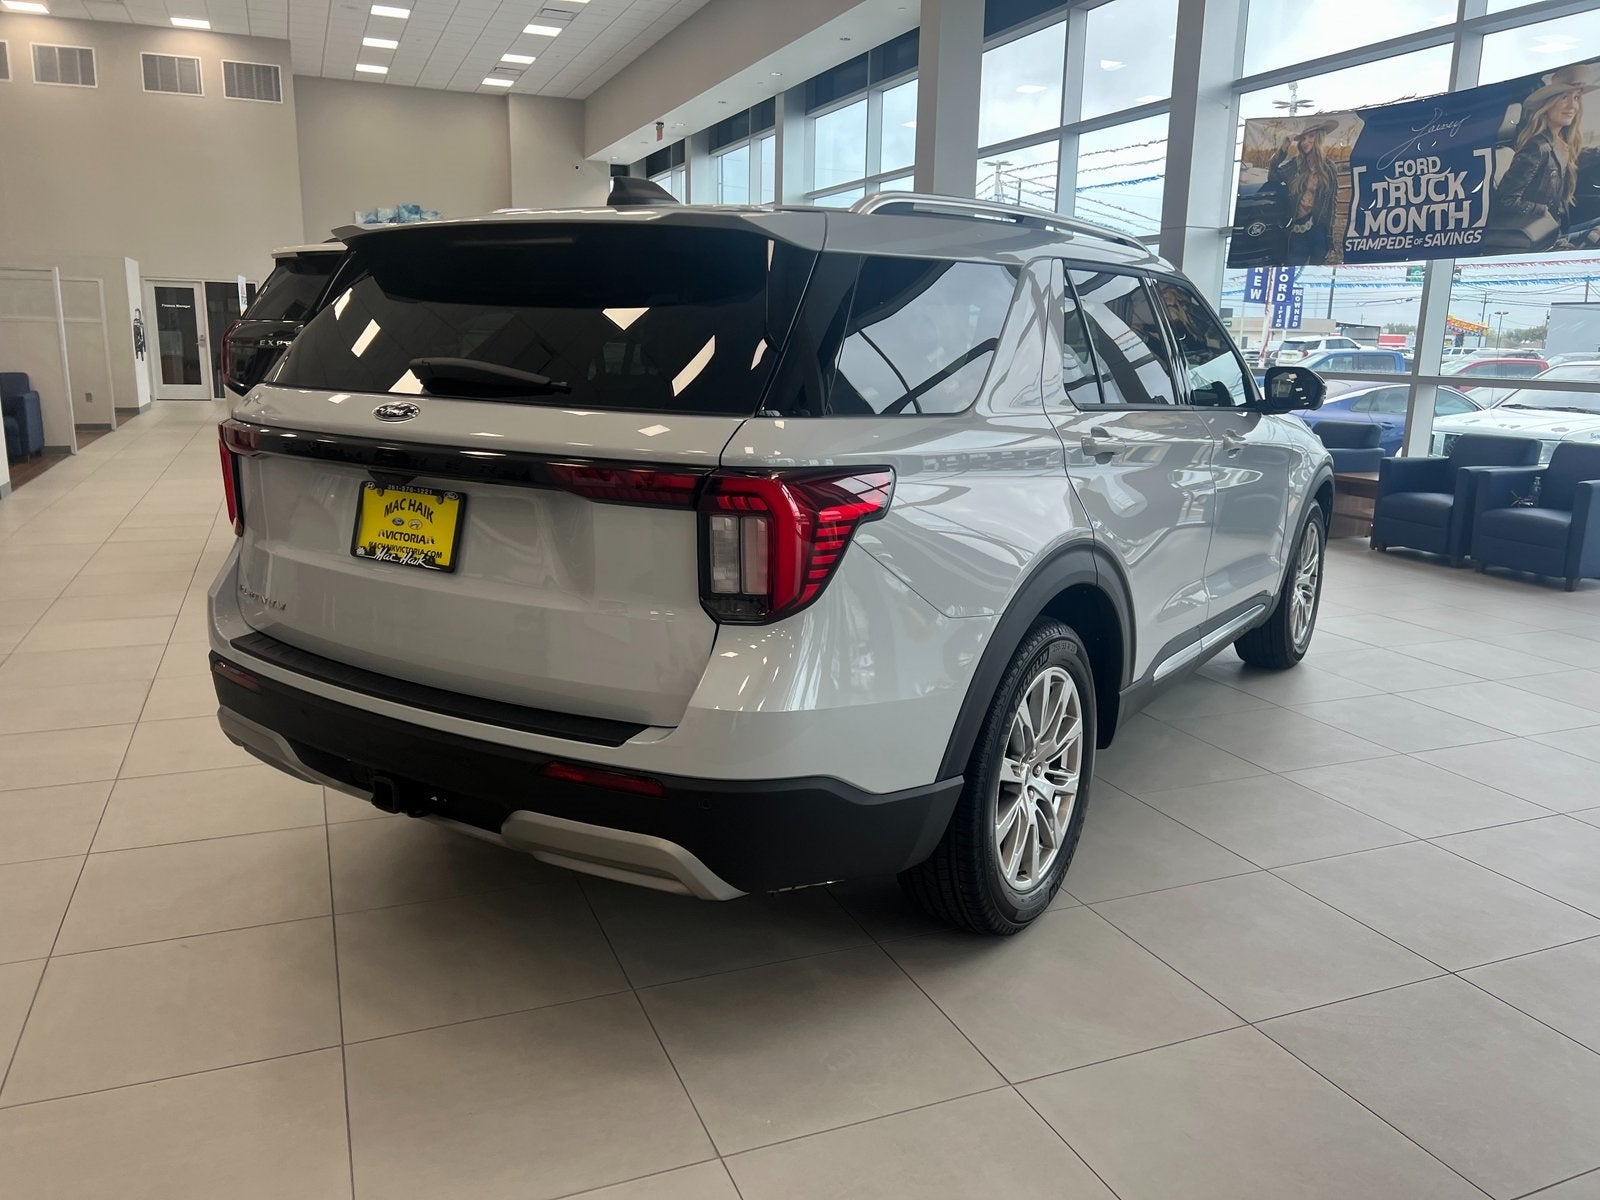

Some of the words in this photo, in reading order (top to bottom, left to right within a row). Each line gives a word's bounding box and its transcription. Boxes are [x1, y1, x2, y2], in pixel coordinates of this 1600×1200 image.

[1395, 156, 1441, 178] FORD
[1372, 168, 1468, 209] TRUCK
[1363, 200, 1472, 237] MONTH
[1345, 235, 1414, 252] STAMPEDE
[1423, 229, 1483, 247] SAVINGS
[384, 498, 406, 518] MAC
[408, 498, 434, 524] HAIK
[385, 530, 426, 545] VICTORIA
[374, 547, 399, 561] Mac
[399, 552, 430, 567] Haik
